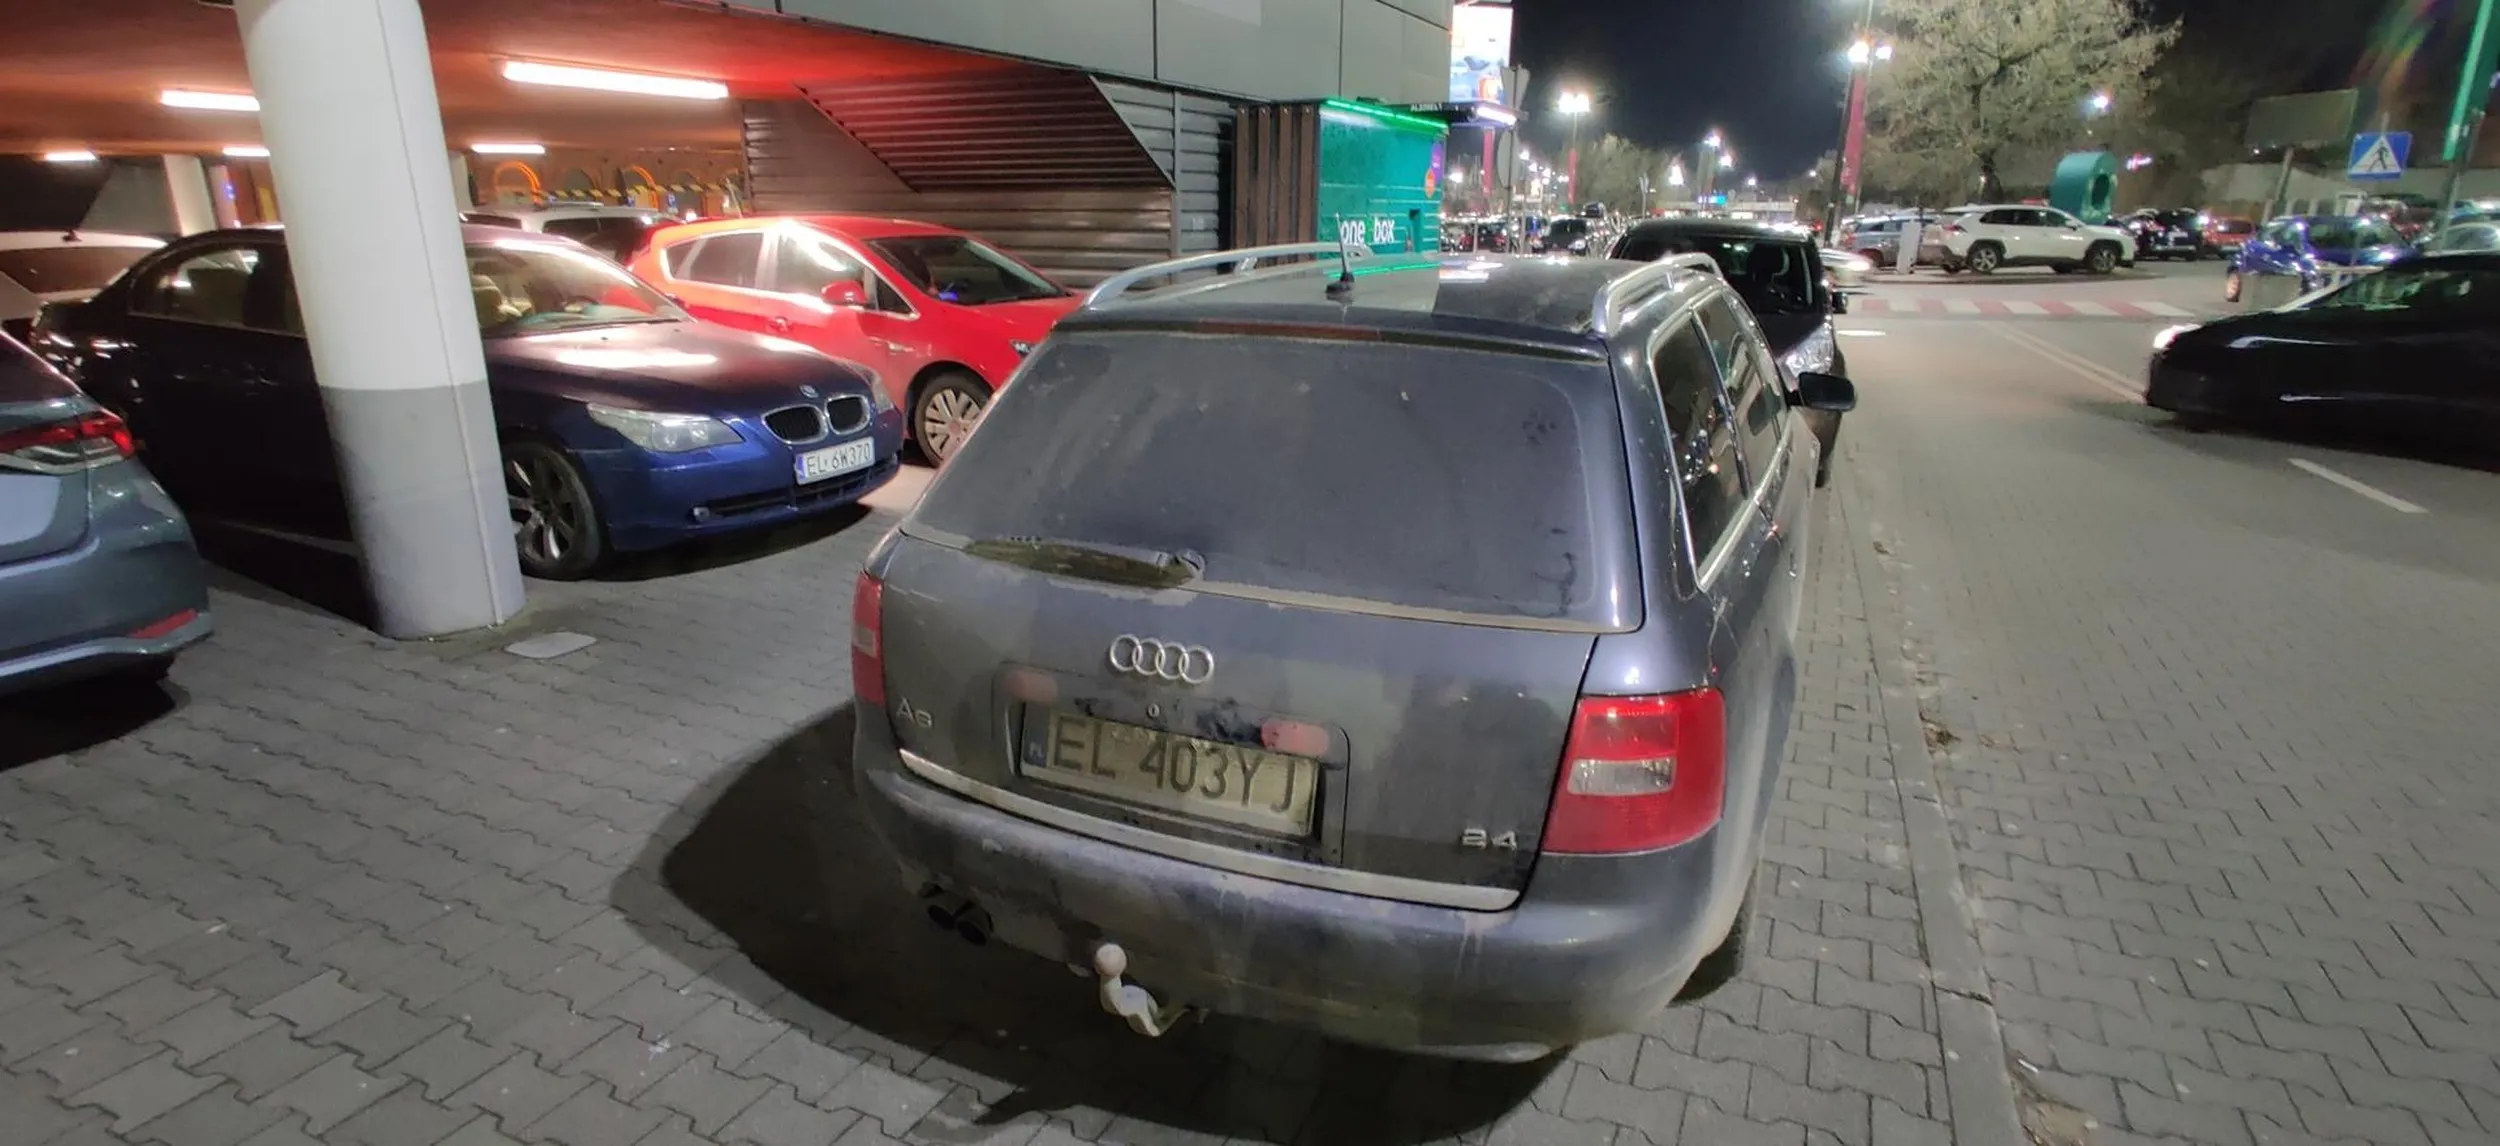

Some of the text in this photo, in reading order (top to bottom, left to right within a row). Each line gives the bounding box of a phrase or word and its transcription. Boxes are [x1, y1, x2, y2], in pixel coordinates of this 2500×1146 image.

[1340, 217, 1396, 246] one box
[806, 442, 871, 477] EL 6W370
[896, 697, 932, 728] A6
[1052, 714, 1297, 814] EL 403YJ
